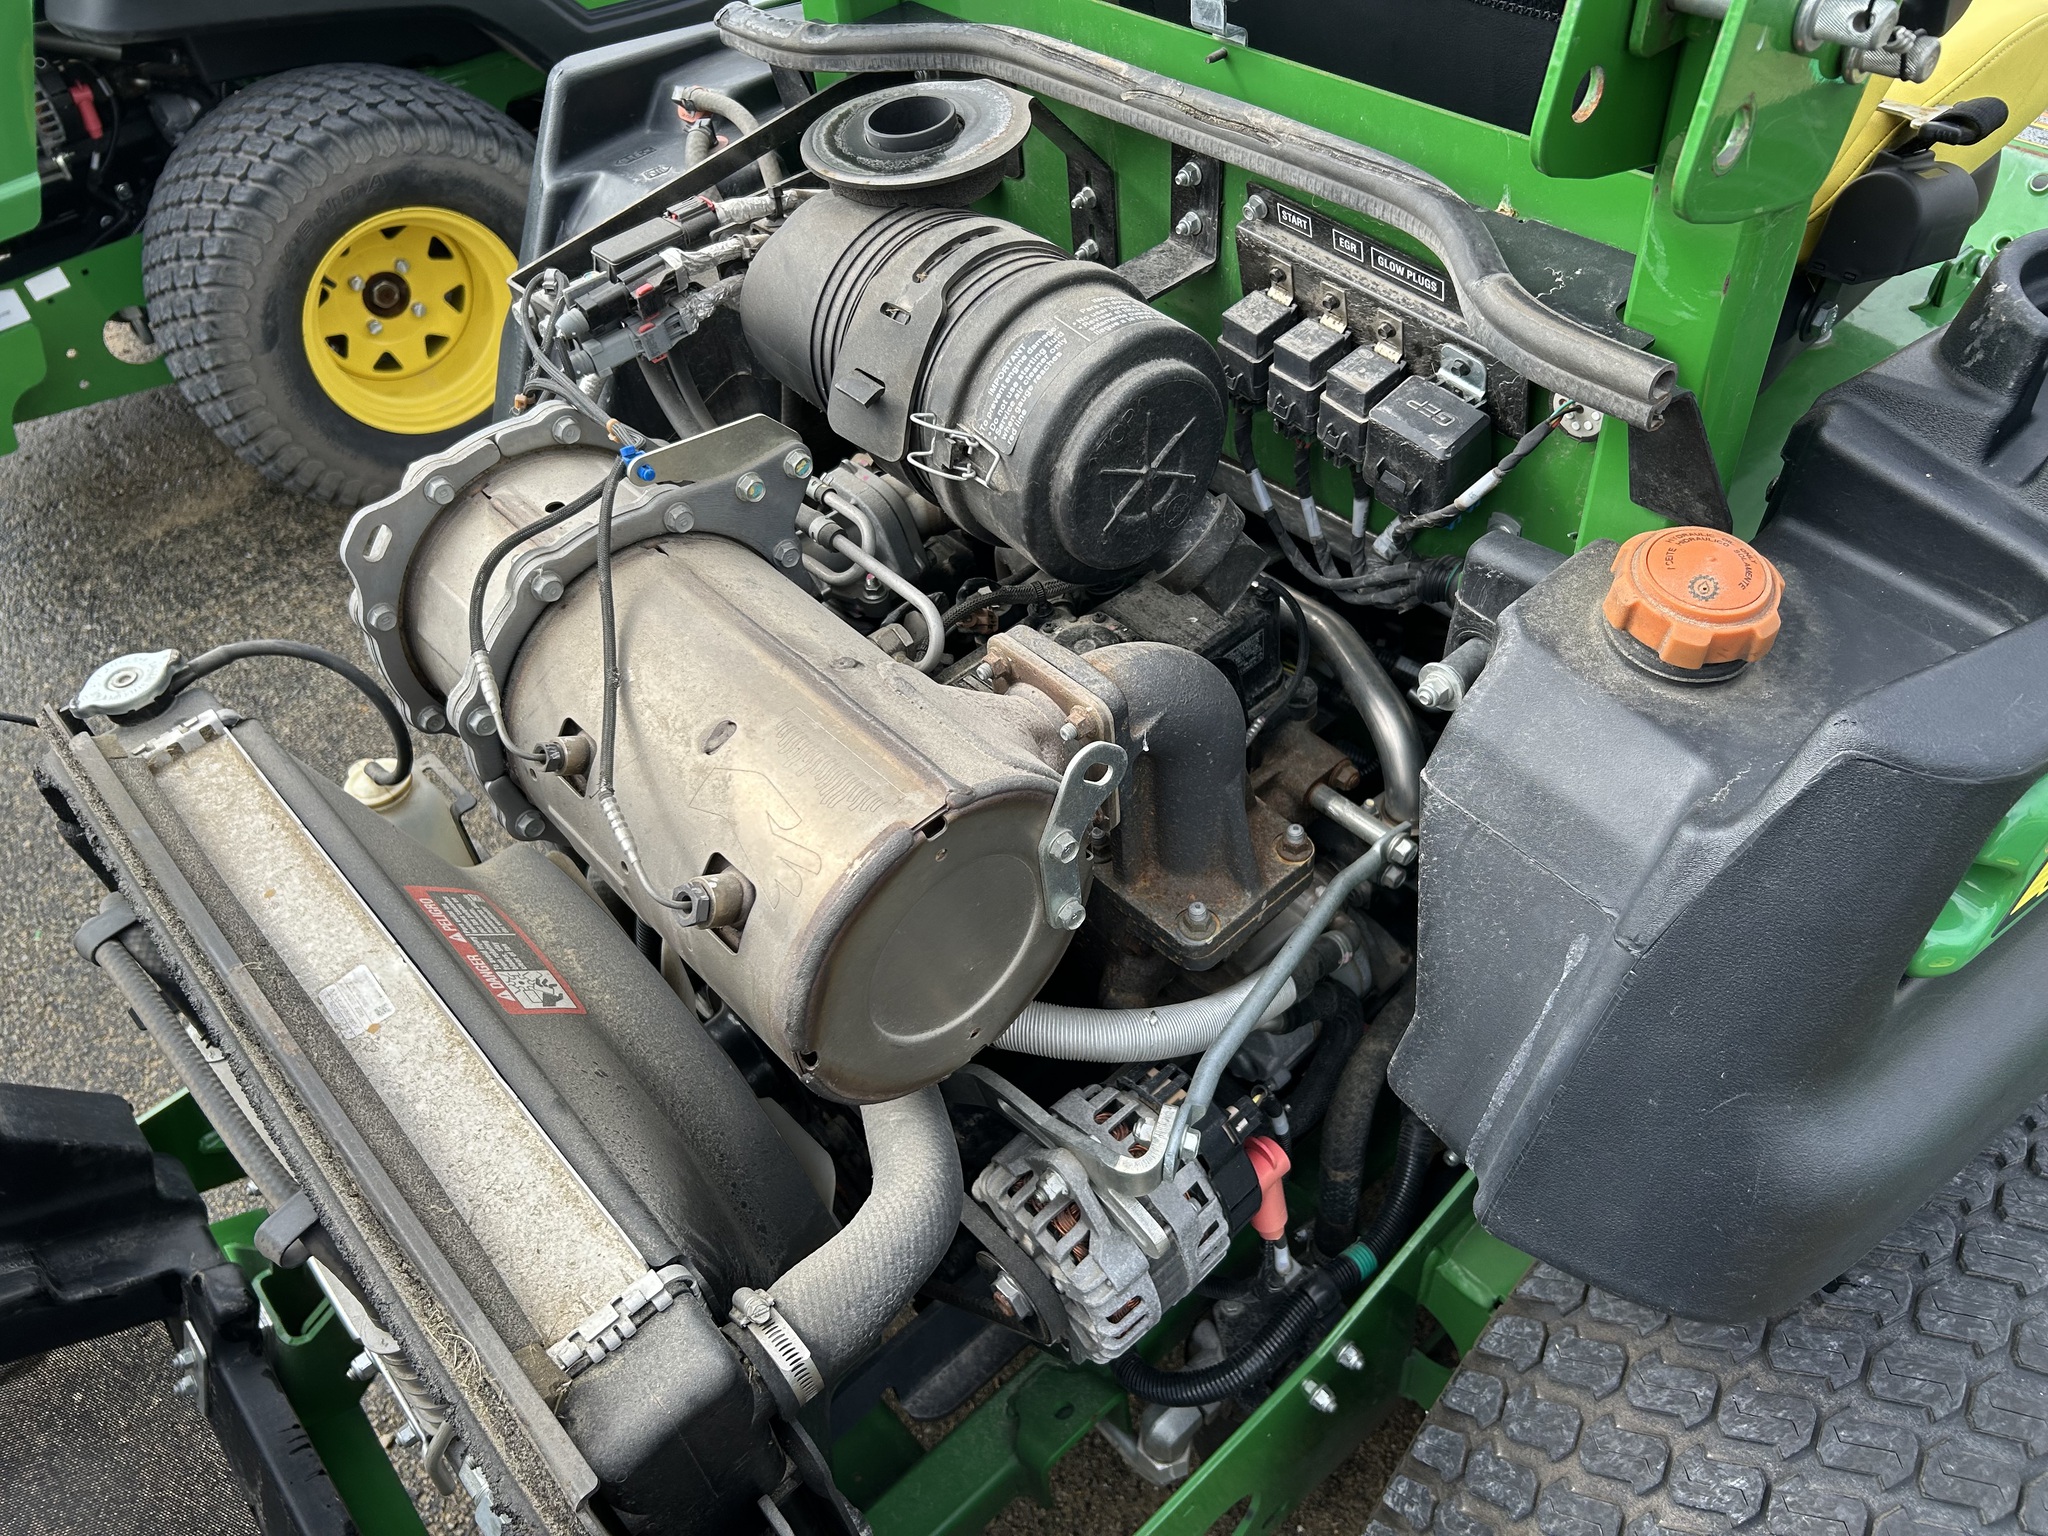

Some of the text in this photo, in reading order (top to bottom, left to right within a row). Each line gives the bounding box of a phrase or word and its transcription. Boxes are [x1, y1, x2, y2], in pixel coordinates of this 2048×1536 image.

[1281, 210, 1308, 230] START
[1339, 237, 1357, 254] EGR
[1377, 255, 1438, 292] GLOW PLUGS
[988, 343, 1026, 396] IMPORTANT
[989, 330, 1065, 432] Do not use starting fluid
[995, 337, 1068, 436] Service air cleaner only
[979, 419, 989, 432] To
[986, 383, 1007, 420] prevent
[1004, 354, 1027, 384] engine
[1001, 351, 1063, 441] when gauge reaches
[1007, 408, 1027, 446] red line
[1675, 536, 1730, 548] HIDRAULICO
[1739, 548, 1758, 565] ONLY
[419, 897, 457, 932] PELIGRO
[466, 953, 504, 990] DANGER
